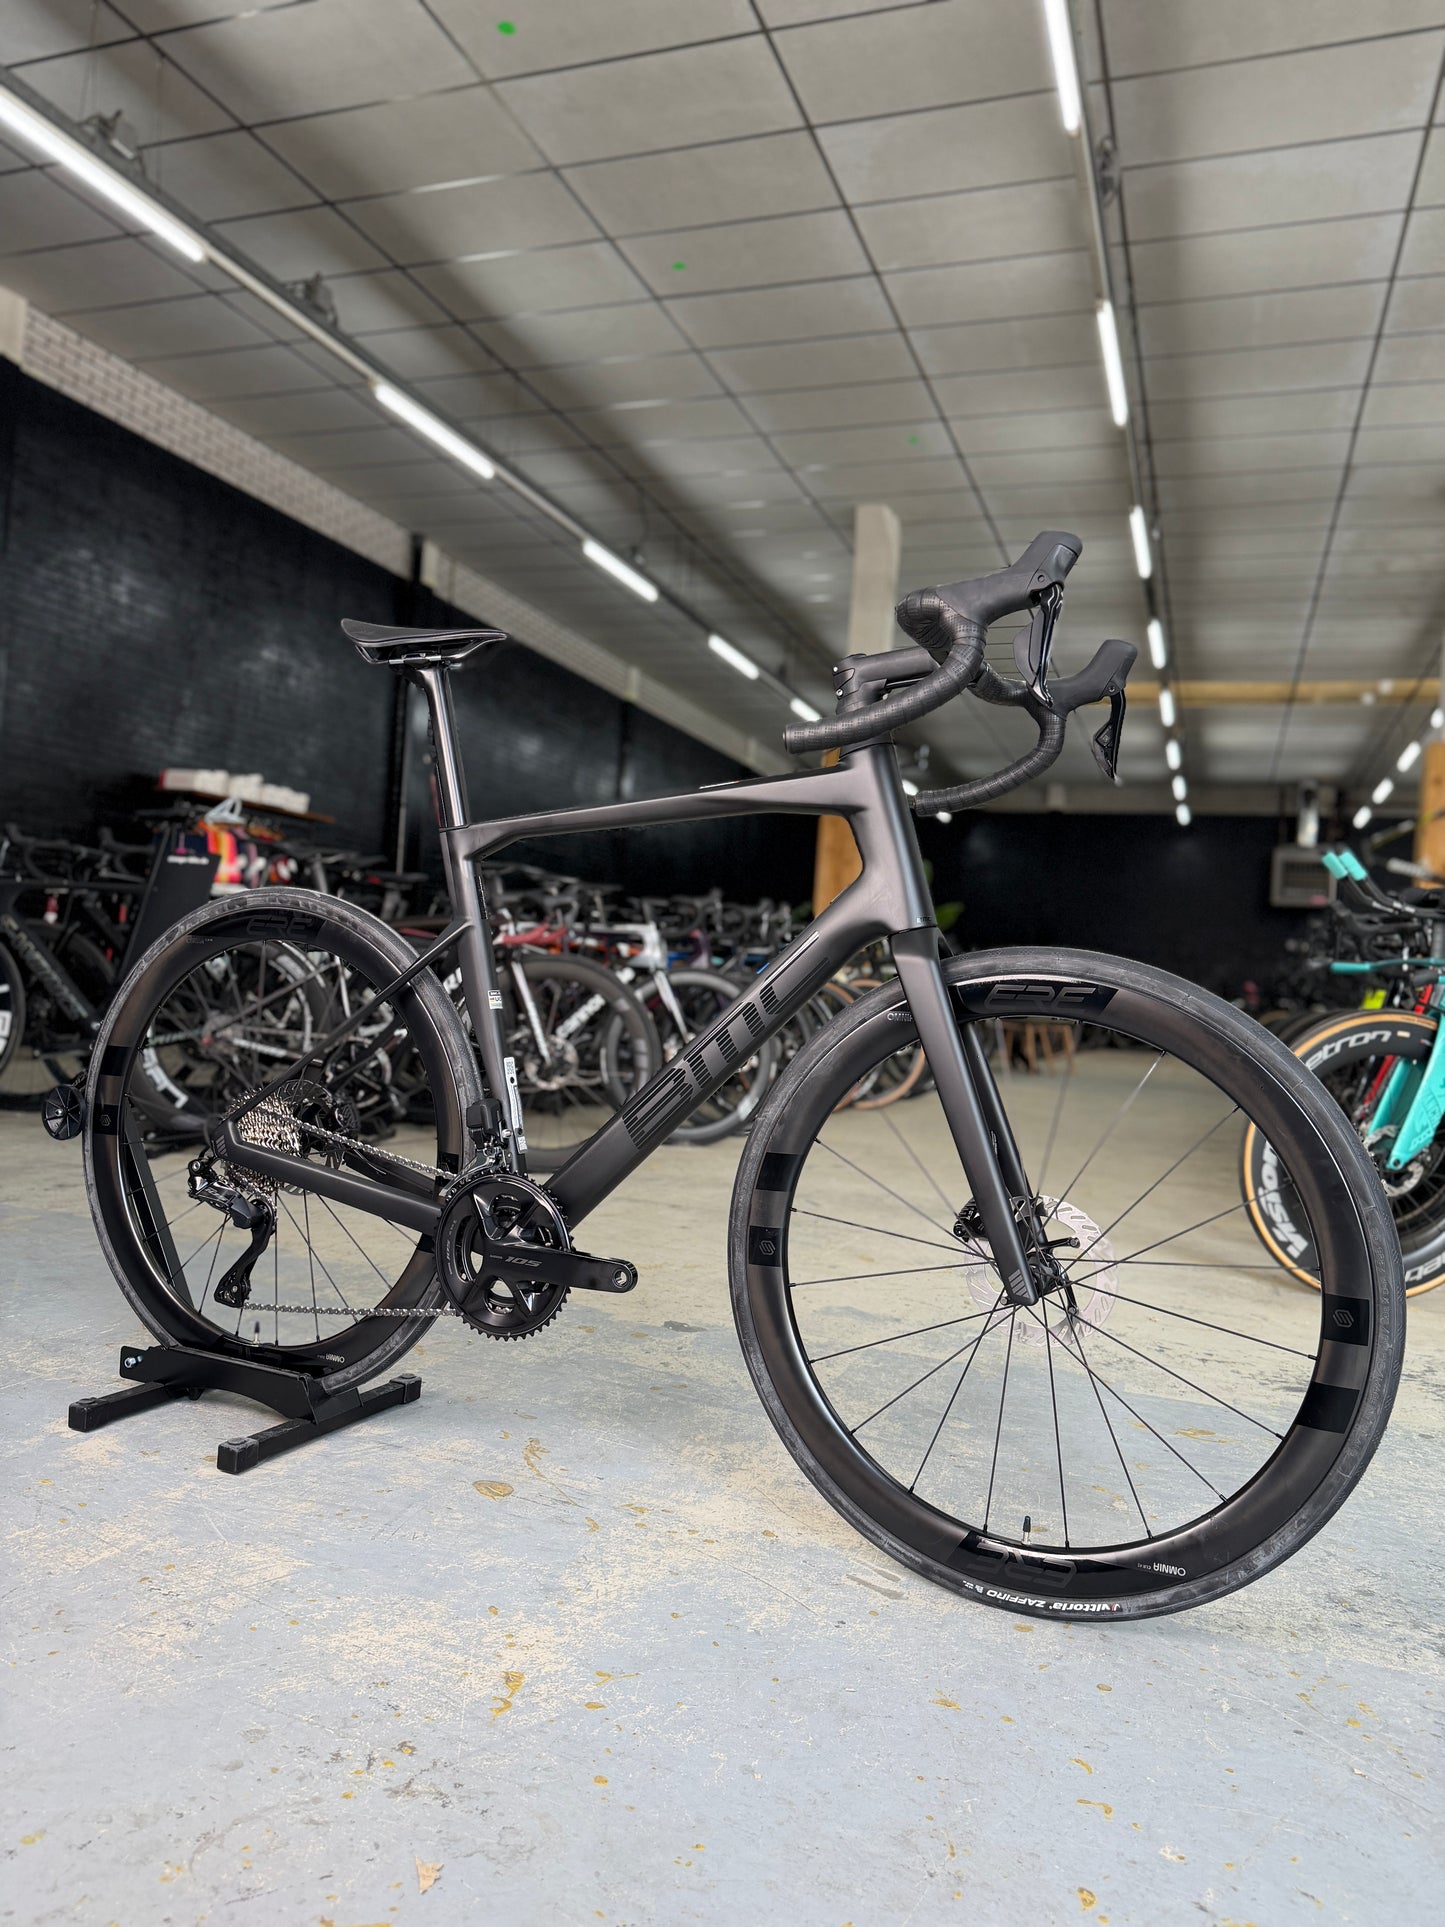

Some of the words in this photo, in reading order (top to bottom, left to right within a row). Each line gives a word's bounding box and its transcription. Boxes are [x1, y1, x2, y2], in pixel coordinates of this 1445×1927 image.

[984, 984, 1097, 1011] ERE
[1305, 1030, 1392, 1071] etron
[505, 1256, 543, 1267] 105
[1153, 1562, 1186, 1577] OMNIA
[986, 1589, 1046, 1608] ZAFFIRO
